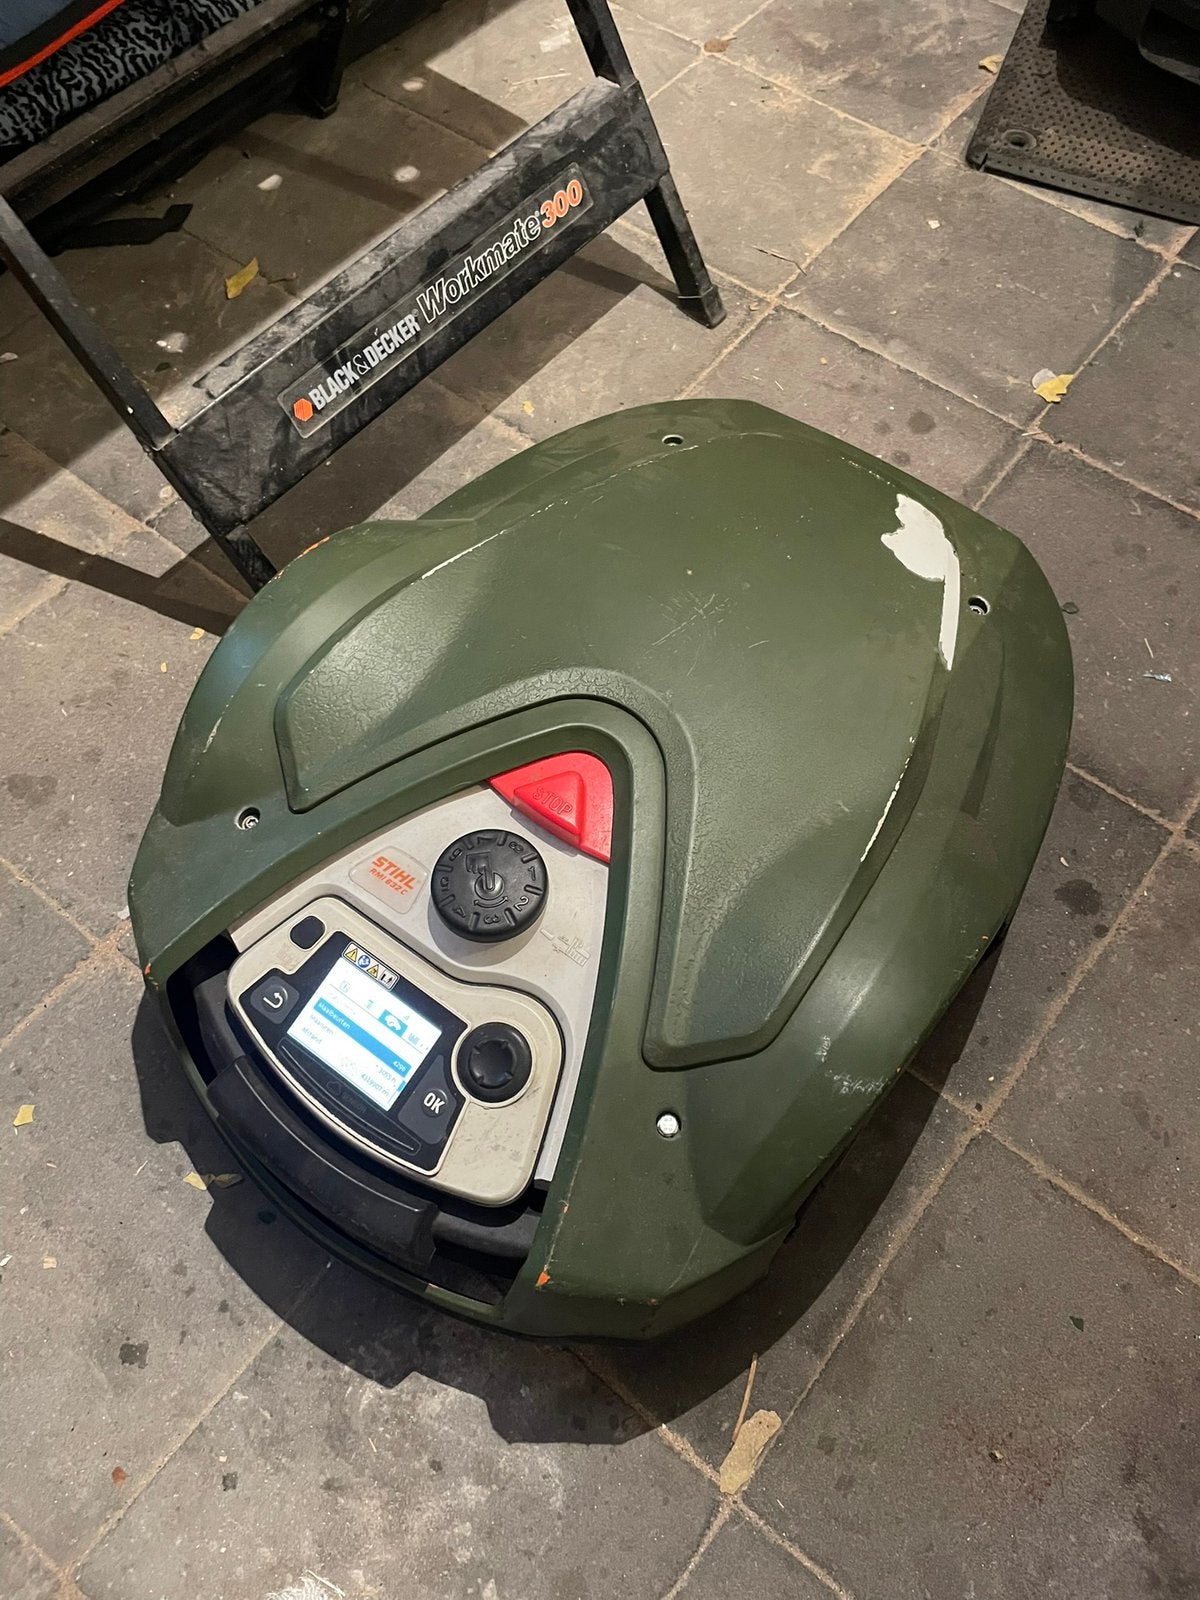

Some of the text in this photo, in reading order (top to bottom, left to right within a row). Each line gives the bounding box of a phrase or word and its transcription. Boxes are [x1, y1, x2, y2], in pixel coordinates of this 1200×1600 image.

[416, 215, 542, 323] Workmate
[540, 179, 583, 228] 300
[532, 785, 574, 816] STOP
[369, 868, 387, 881] RMI
[372, 856, 417, 890] STIHL
[513, 895, 530, 912] 2
[423, 1092, 446, 1114] OK
